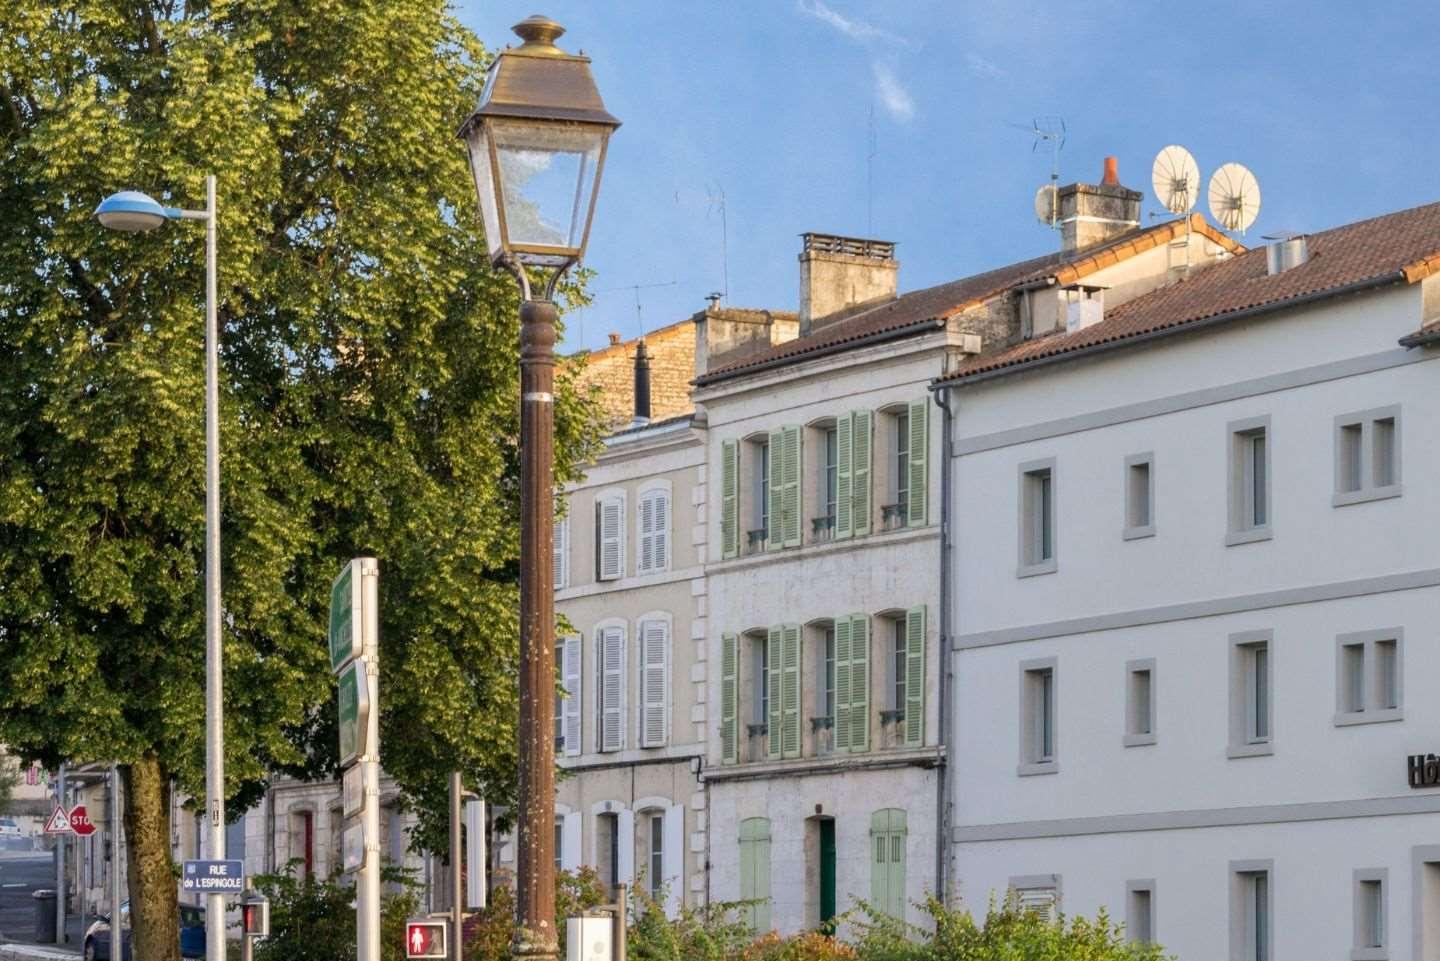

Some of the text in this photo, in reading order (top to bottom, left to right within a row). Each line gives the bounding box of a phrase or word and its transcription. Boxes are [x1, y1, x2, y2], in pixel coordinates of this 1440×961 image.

[72, 816, 89, 825] STO
[209, 865, 228, 875] RUE
[184, 878, 241, 888] de L'ESPINGOLE
